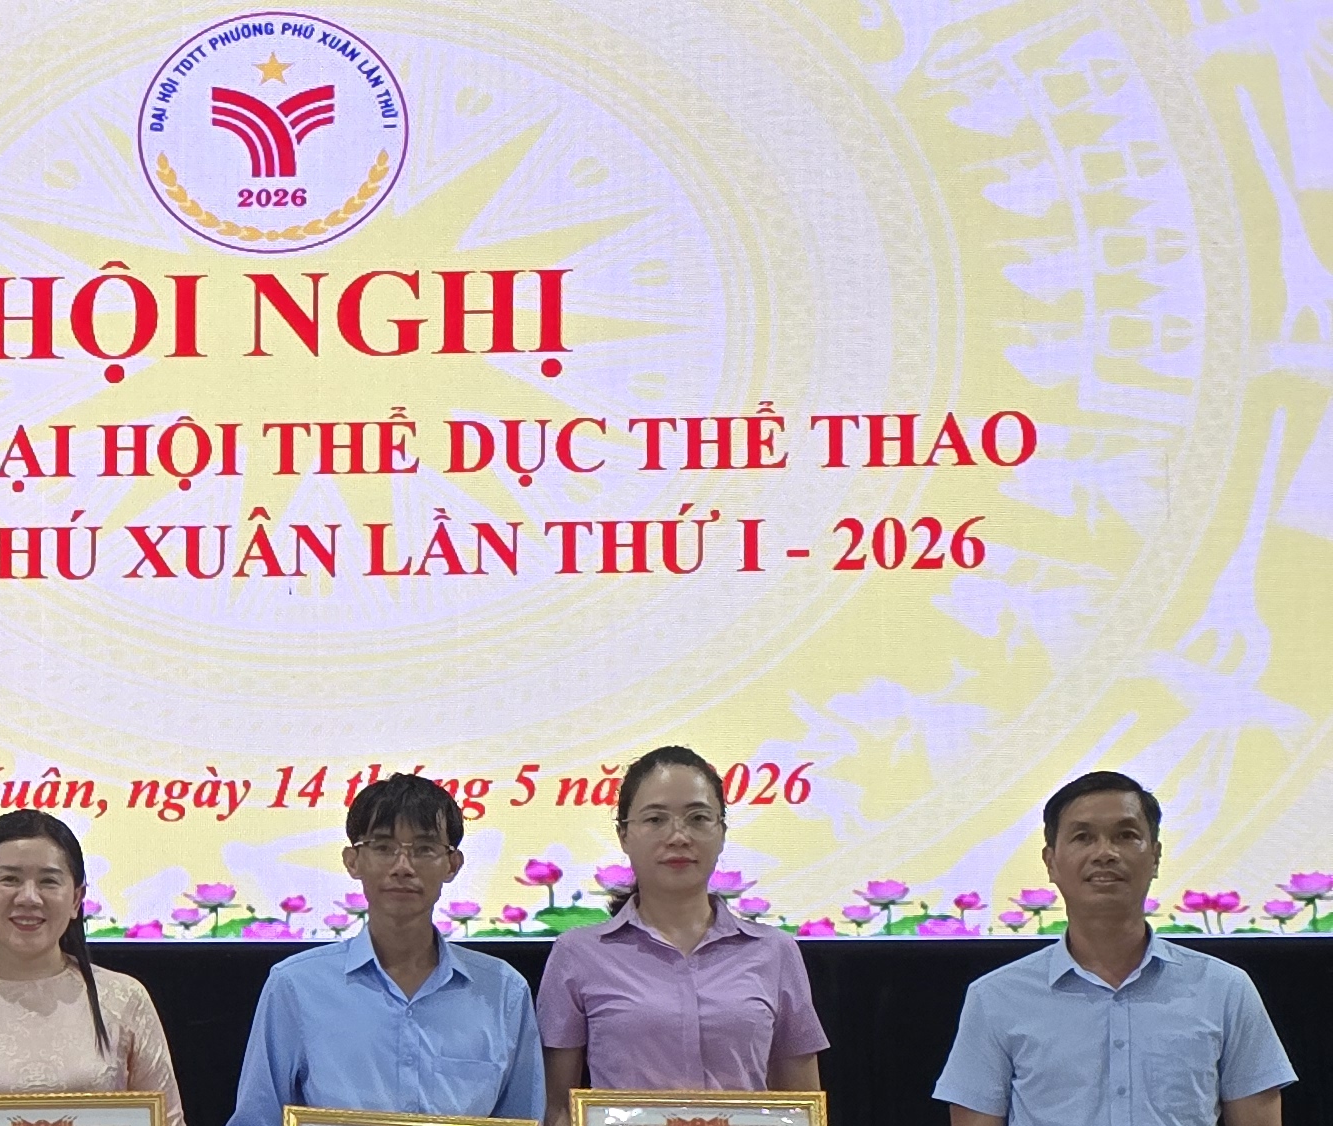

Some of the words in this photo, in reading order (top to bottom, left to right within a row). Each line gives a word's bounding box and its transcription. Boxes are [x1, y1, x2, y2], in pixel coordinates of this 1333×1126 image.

[173, 44, 207, 76] TDTT
[237, 187, 307, 208] 2026
[244, 268, 573, 378] NGHỊ
[97, 416, 243, 491] HỘI
[263, 407, 420, 476] THỂ
[443, 417, 607, 488] DỤC
[628, 401, 788, 470] THỂ
[811, 411, 1038, 469] THAO
[125, 506, 343, 580] XUÂN
[363, 507, 523, 577] LẦN
[544, 503, 721, 576] THỨ
[737, 519, 766, 573] I
[786, 549, 810, 558] -
[832, 516, 987, 572] 2026
[126, 766, 252, 822] ngày
[267, 765, 329, 809] 14
[510, 764, 541, 807] 5
[555, 763, 623, 806] nă
[705, 762, 815, 806] 026
